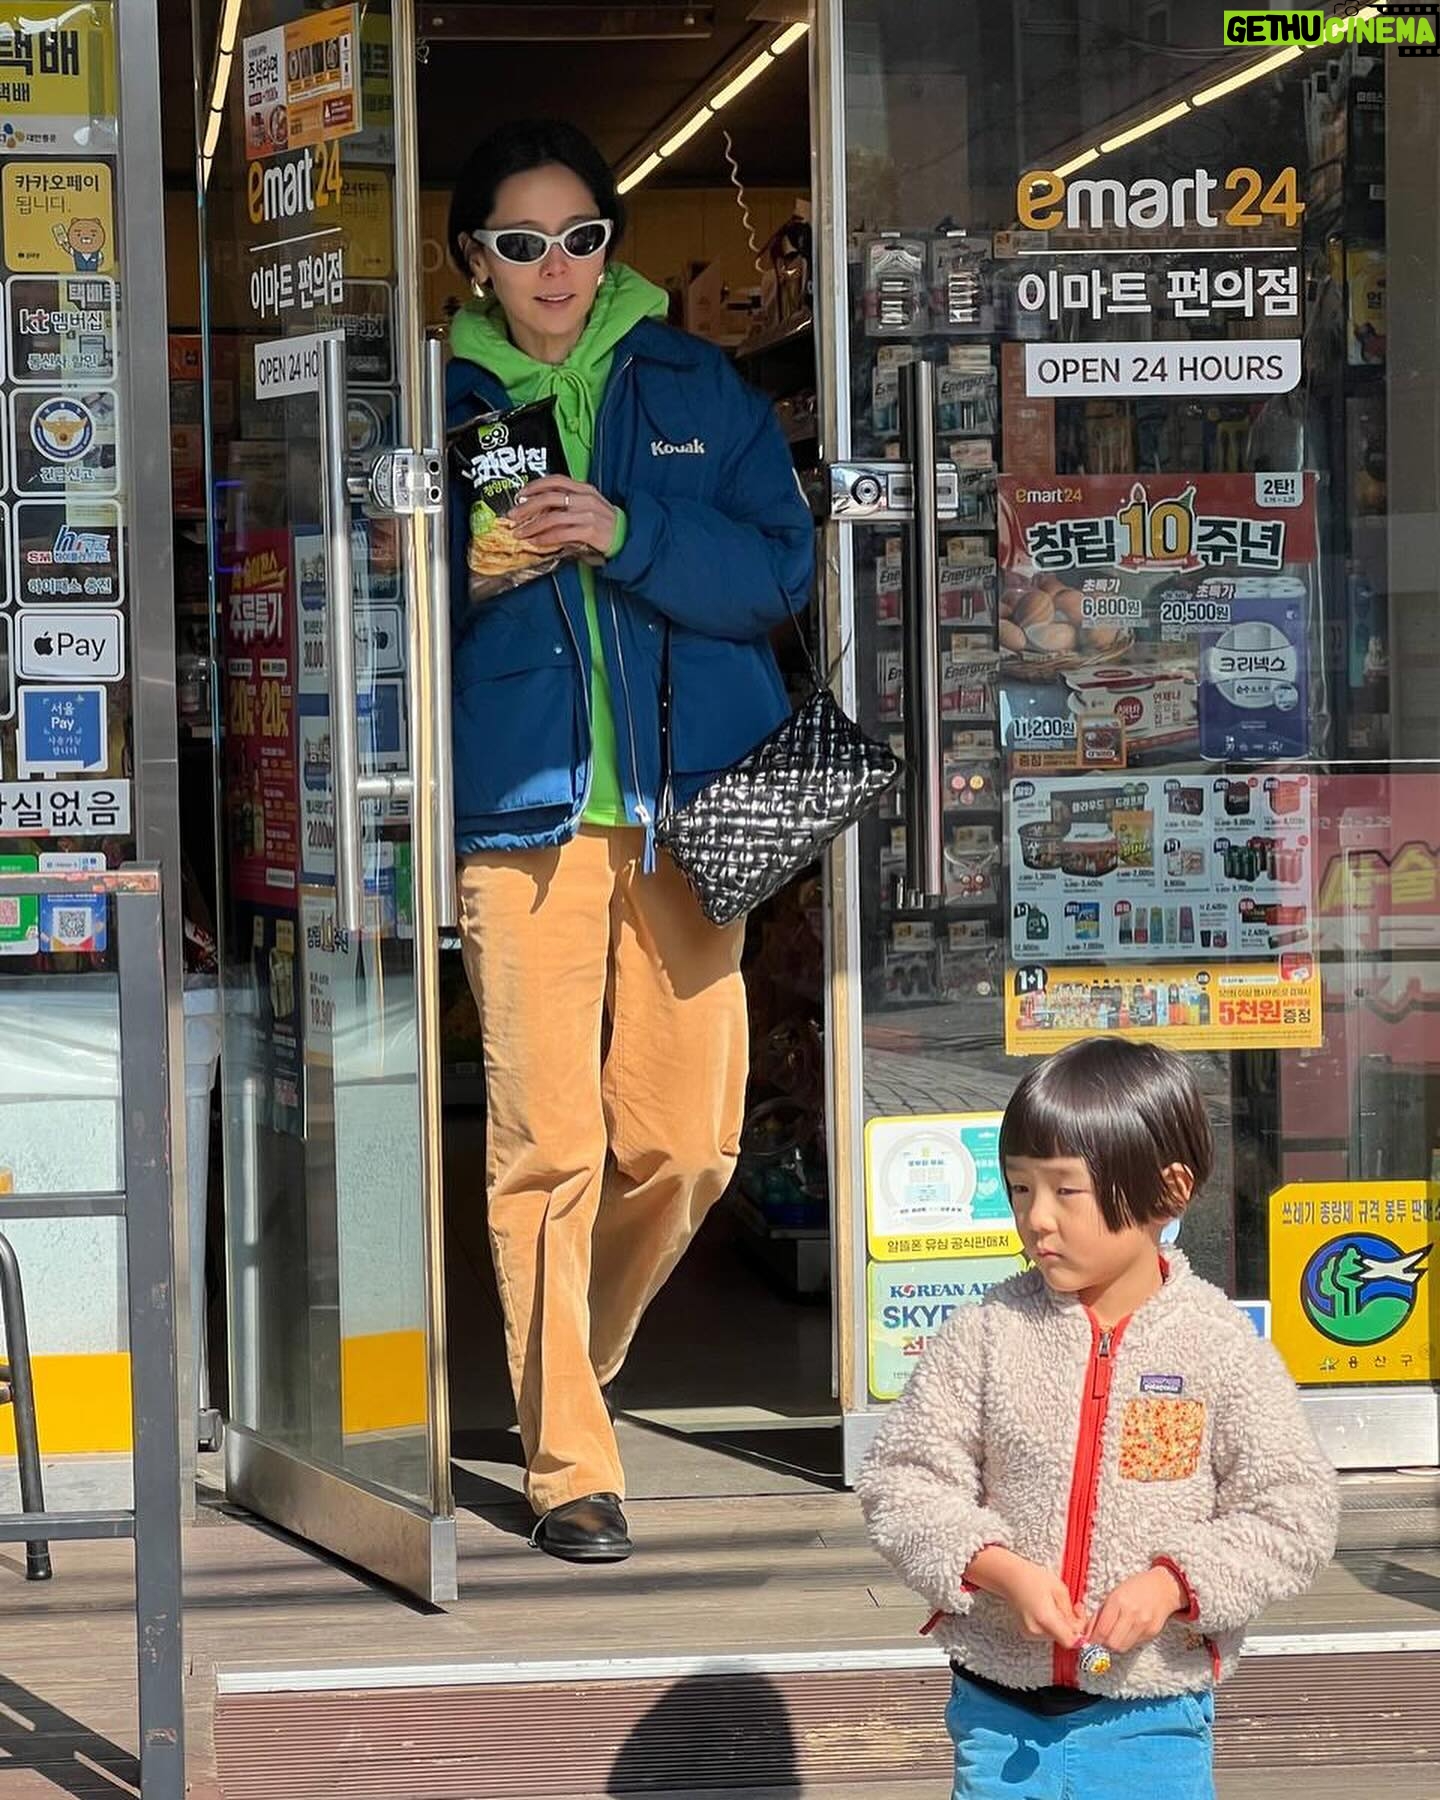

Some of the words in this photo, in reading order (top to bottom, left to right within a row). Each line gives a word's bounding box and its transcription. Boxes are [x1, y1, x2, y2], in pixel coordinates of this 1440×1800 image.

[15, 174, 99, 192] 카카오페이
[1017, 167, 1305, 230] emart24
[251, 263, 295, 318] 이마트
[298, 248, 344, 310] 편의점
[1018, 269, 1152, 320] 이마트
[1167, 267, 1298, 317] 편의점
[259, 357, 286, 386] OPEN
[288, 355, 301, 380] 24
[1038, 358, 1120, 385] OPEN
[1132, 356, 1168, 382] 24
[1179, 355, 1283, 381] HOURS
[1016, 488, 1083, 503] emart24
[1264, 479, 1295, 495] 2탄!
[941, 563, 995, 584] Energizer
[1082, 597, 1141, 620] 6,800원
[1161, 601, 1230, 624] 20,500원
[58, 632, 106, 662] Pay
[1219, 656, 1287, 673] 크리넥스
[51, 701, 75, 716] 서울
[51, 716, 74, 732] Pay
[1014, 718, 1076, 739] 11,200원
[0, 790, 120, 828] 실없음
[1019, 968, 1044, 990] 1+1
[1219, 999, 1282, 1025] 5천원
[1283, 1008, 1311, 1024] 증정
[1283, 1200, 1316, 1225] 쓰레기
[1320, 1200, 1353, 1225] 종량제
[1359, 1200, 1380, 1224] 규격
[1385, 1200, 1407, 1223] 봉투
[887, 1239, 922, 1253] 알뜰폰
[925, 1238, 949, 1251] 유심
[1348, 1355, 1413, 1368] 용산구
